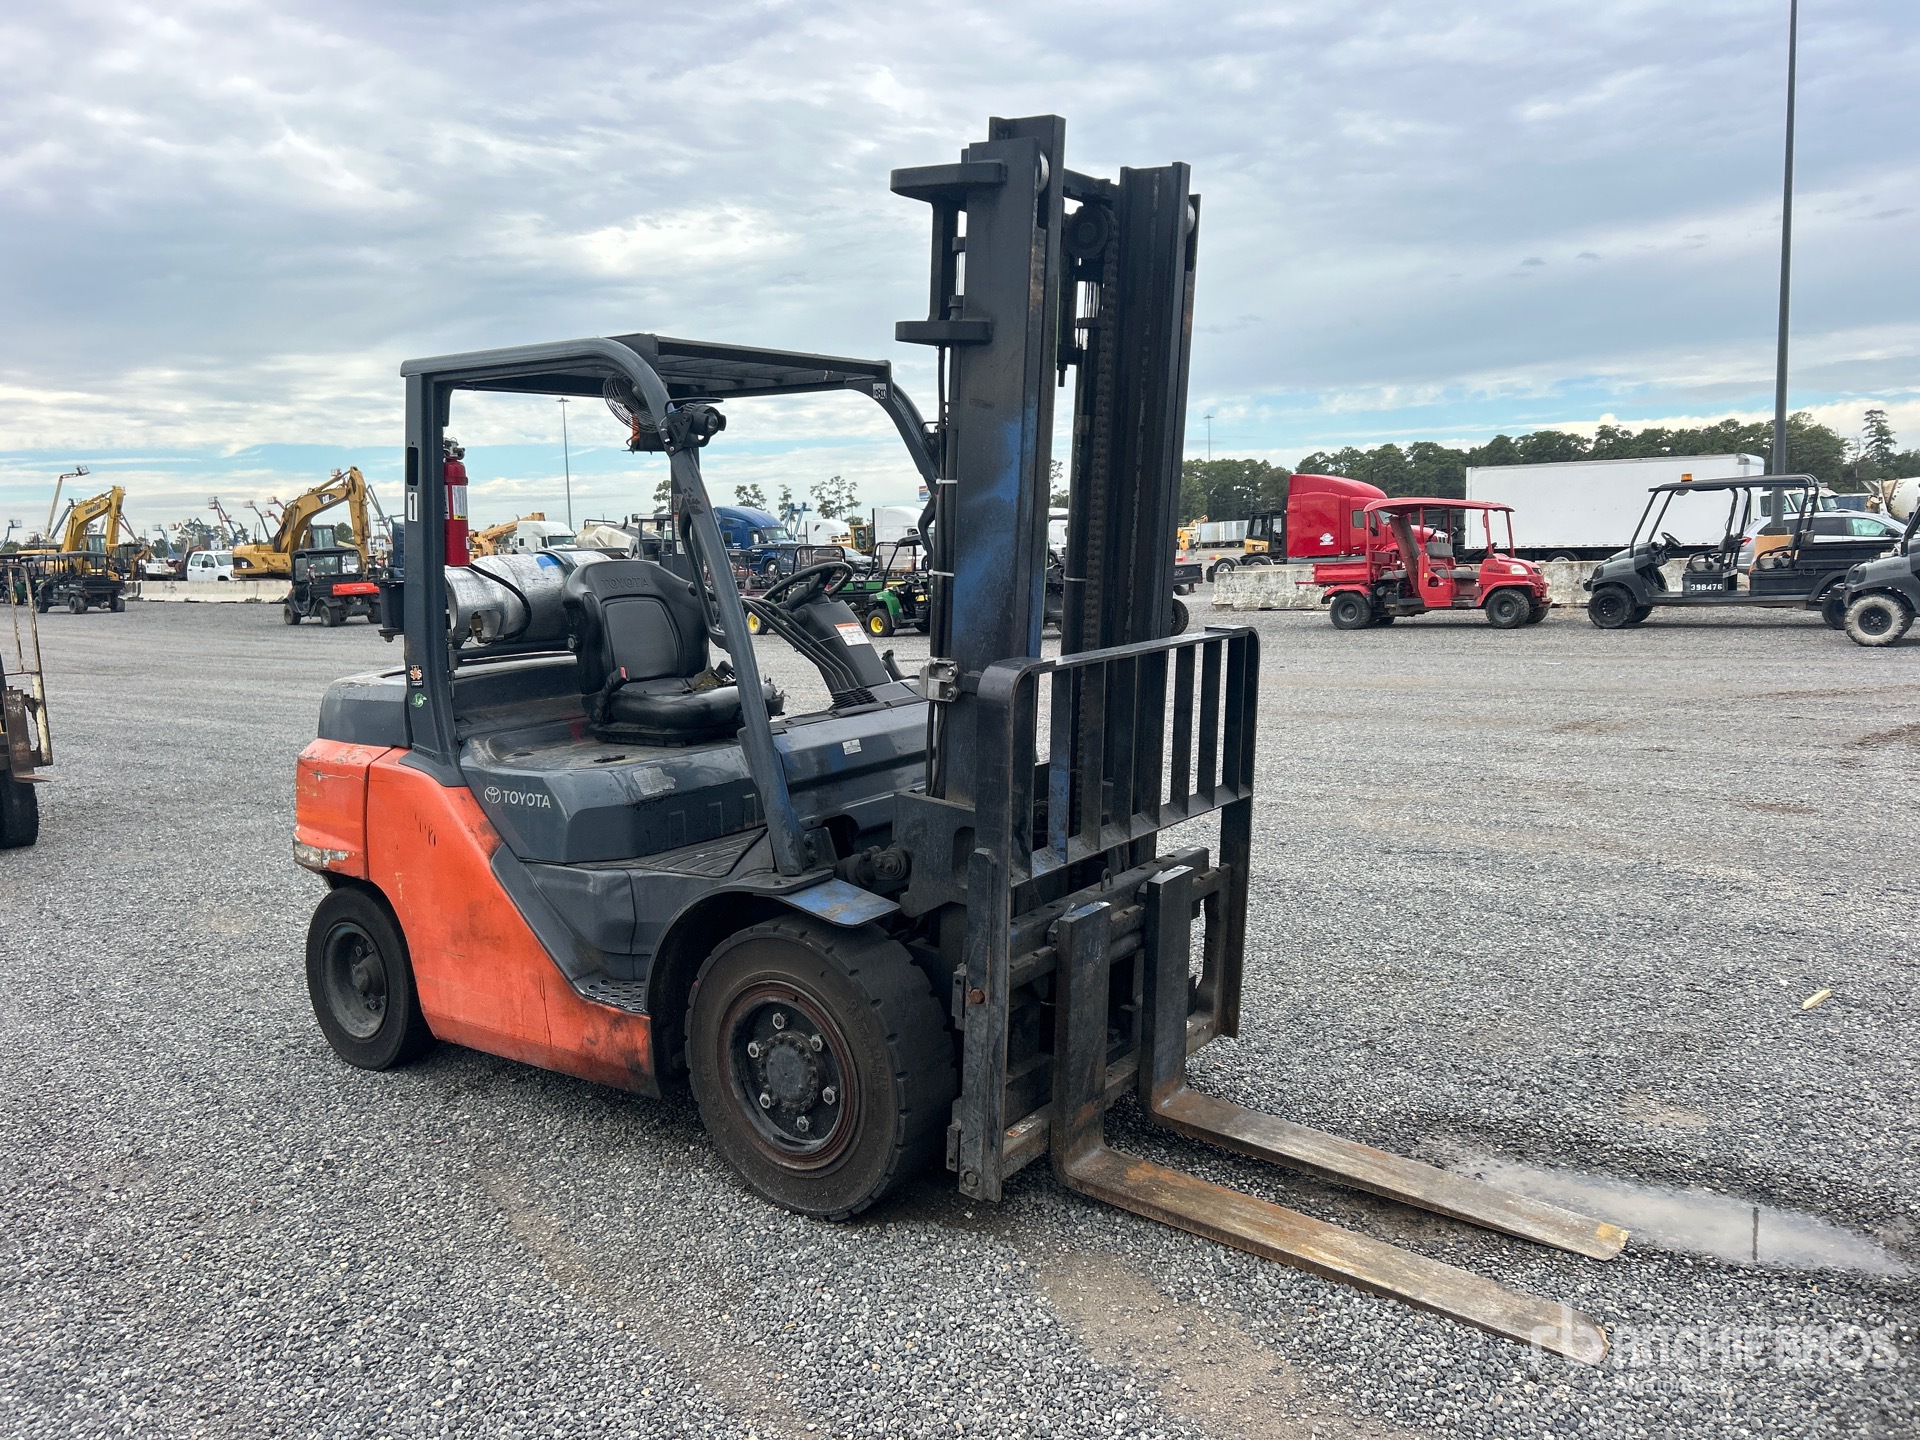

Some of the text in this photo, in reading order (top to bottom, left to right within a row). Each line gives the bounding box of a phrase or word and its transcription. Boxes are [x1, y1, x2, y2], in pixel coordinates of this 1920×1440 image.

[410, 493, 415, 521] 1
[601, 576, 650, 590] TOYOTA
[502, 790, 552, 809] TOYOTA
